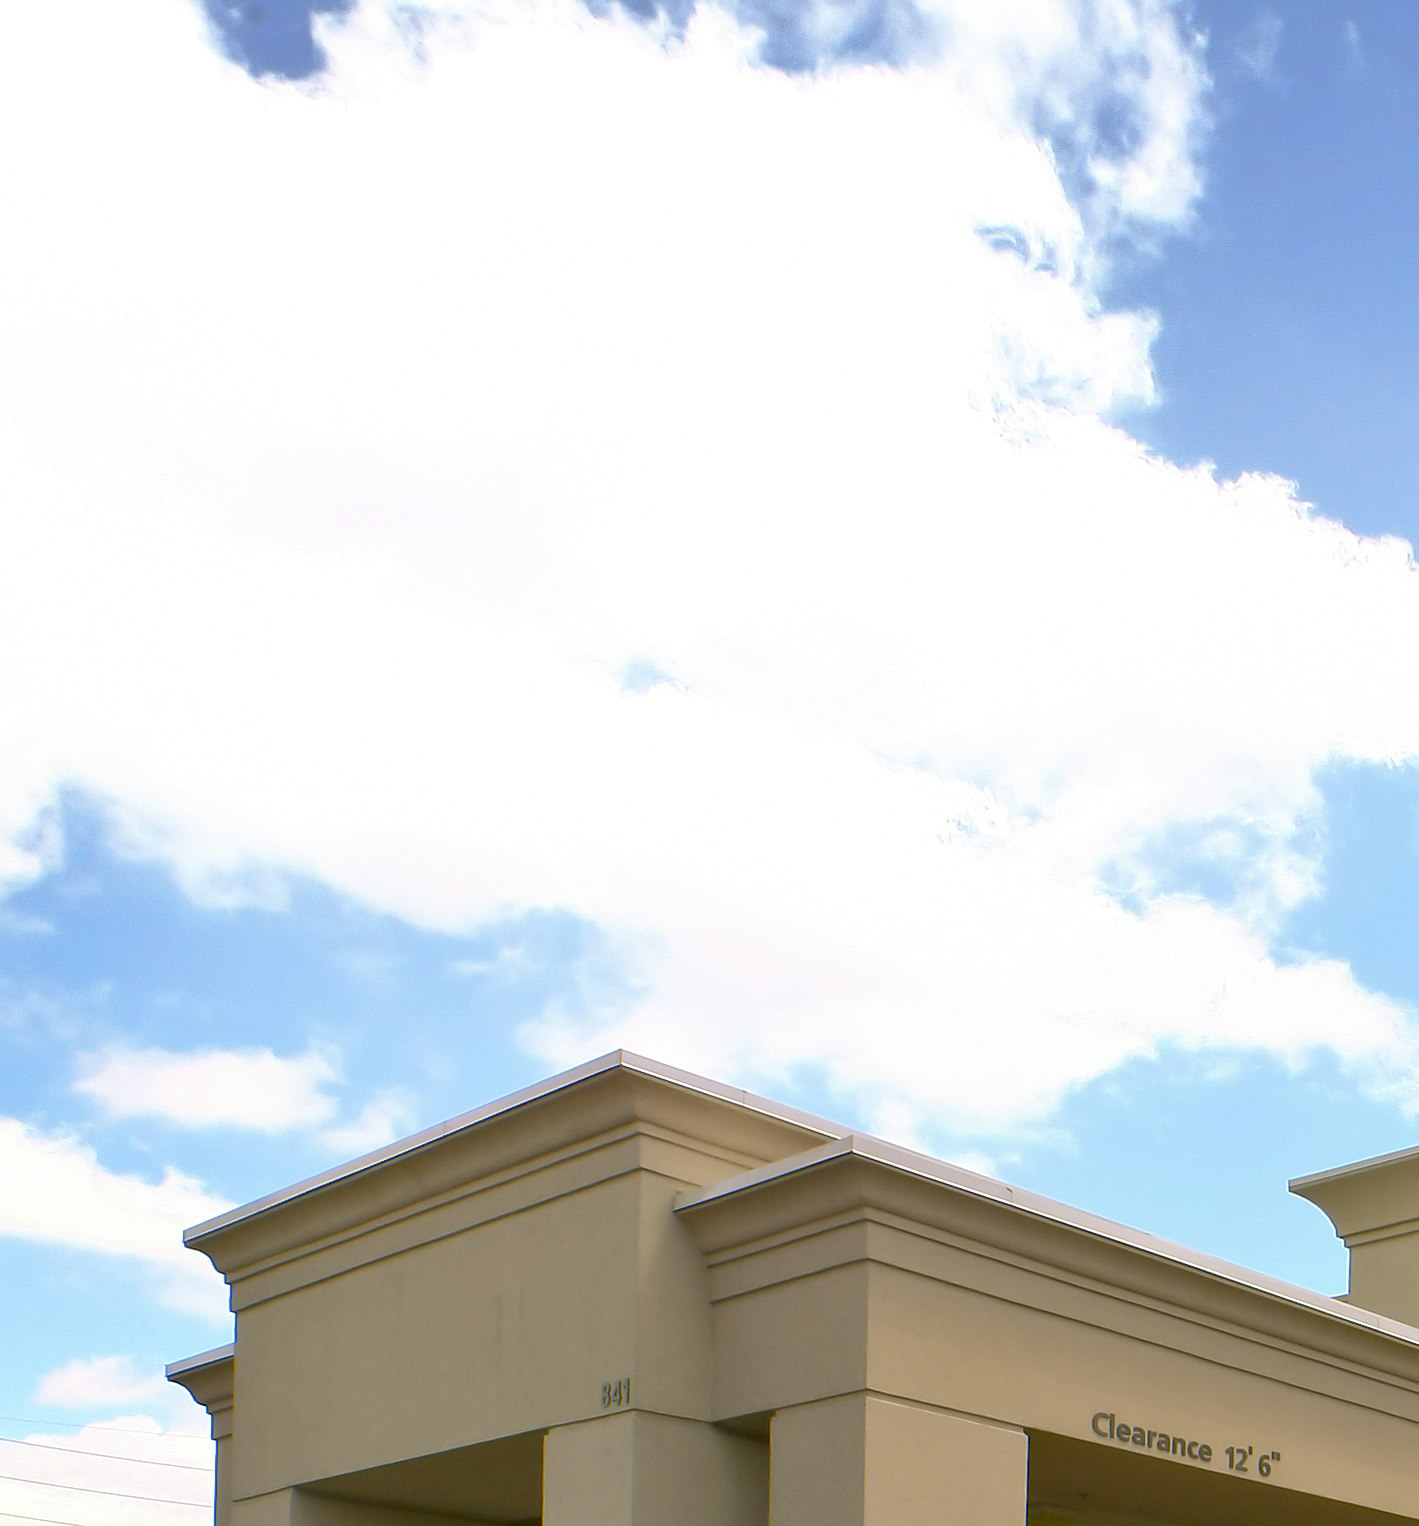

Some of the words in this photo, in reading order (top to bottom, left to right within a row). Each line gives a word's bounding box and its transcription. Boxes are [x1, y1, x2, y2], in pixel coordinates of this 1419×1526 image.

[601, 1378, 630, 1408] 841
[1092, 1412, 1213, 1463] Clearance
[1225, 1446, 1253, 1472] 12'
[1258, 1451, 1281, 1477] 6"
